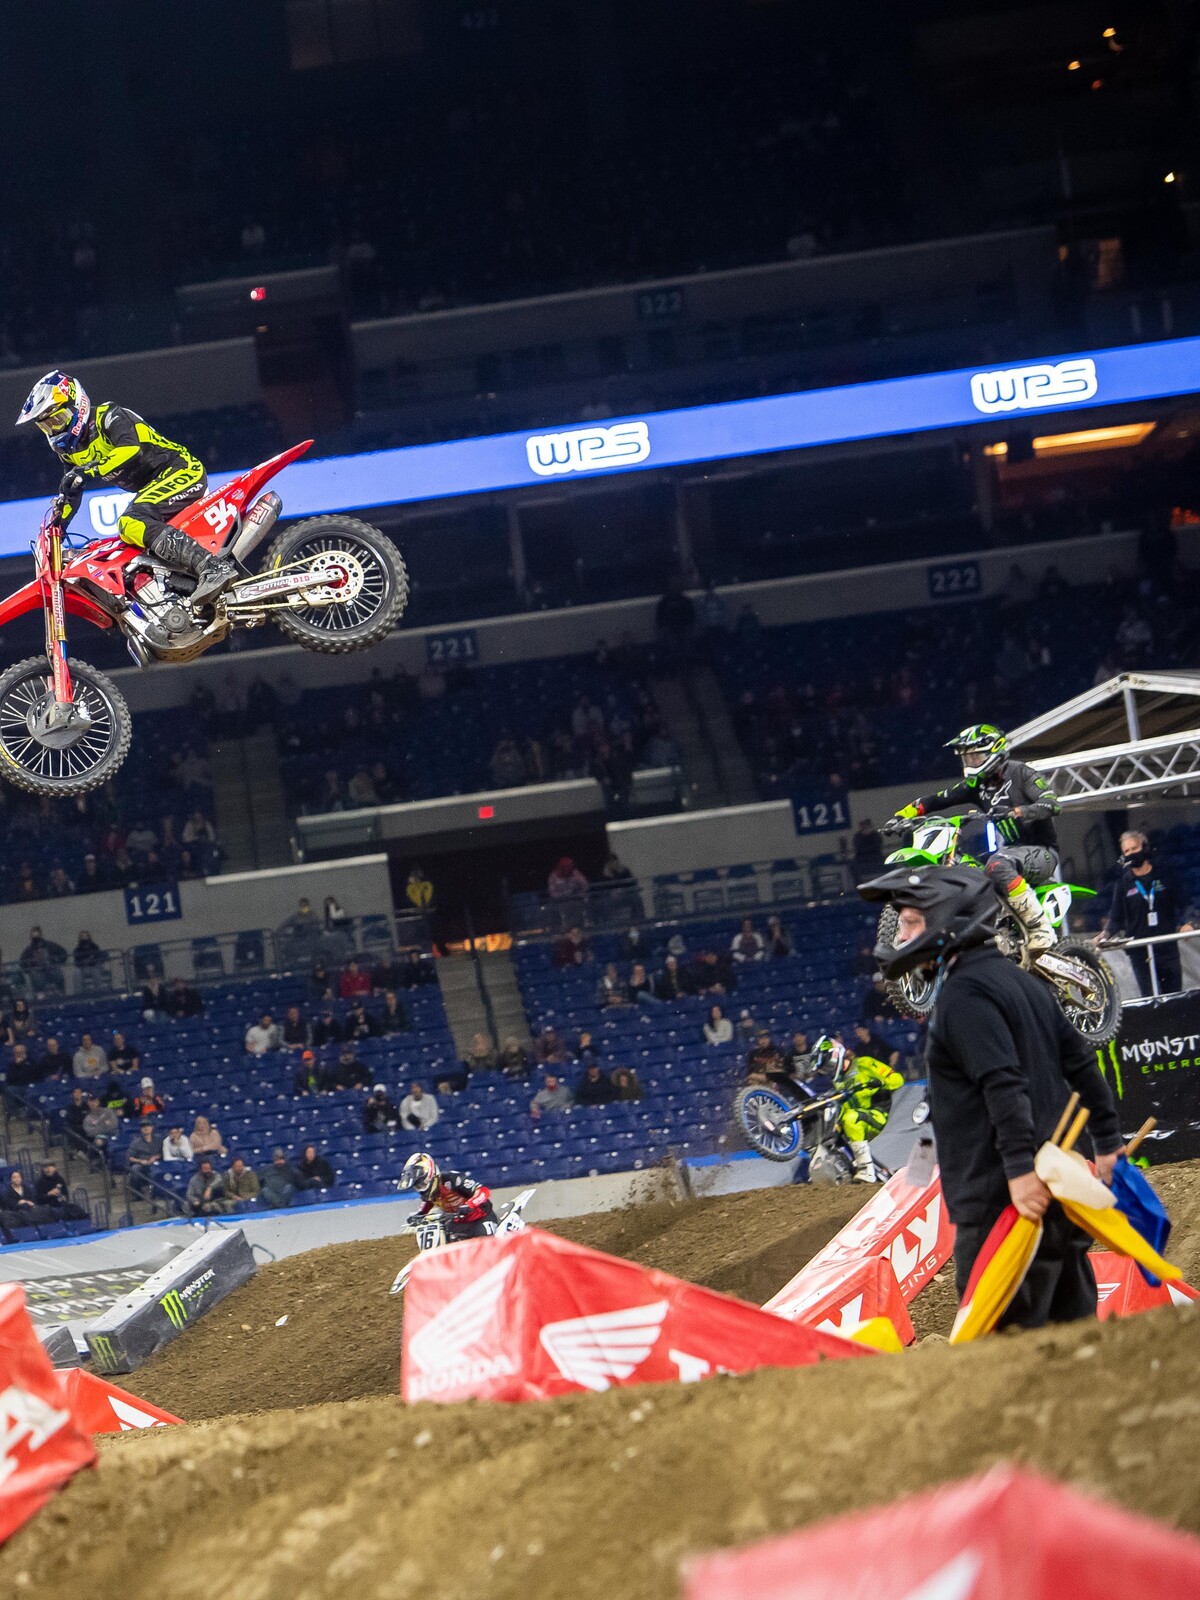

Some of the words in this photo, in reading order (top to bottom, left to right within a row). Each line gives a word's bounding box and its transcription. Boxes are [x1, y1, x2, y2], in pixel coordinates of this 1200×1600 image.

[971, 358, 1097, 414] WPS
[526, 421, 650, 476] WPS
[203, 498, 238, 534] 94
[931, 566, 977, 592] 222
[798, 801, 845, 828] 121
[921, 828, 942, 852] 1
[129, 891, 177, 917] 121
[1046, 893, 1061, 918] 1
[1121, 1034, 1200, 1062] MONST
[1141, 1057, 1200, 1074] ENERG
[178, 1267, 216, 1300] MONSTER
[408, 1354, 513, 1402] HONDA
